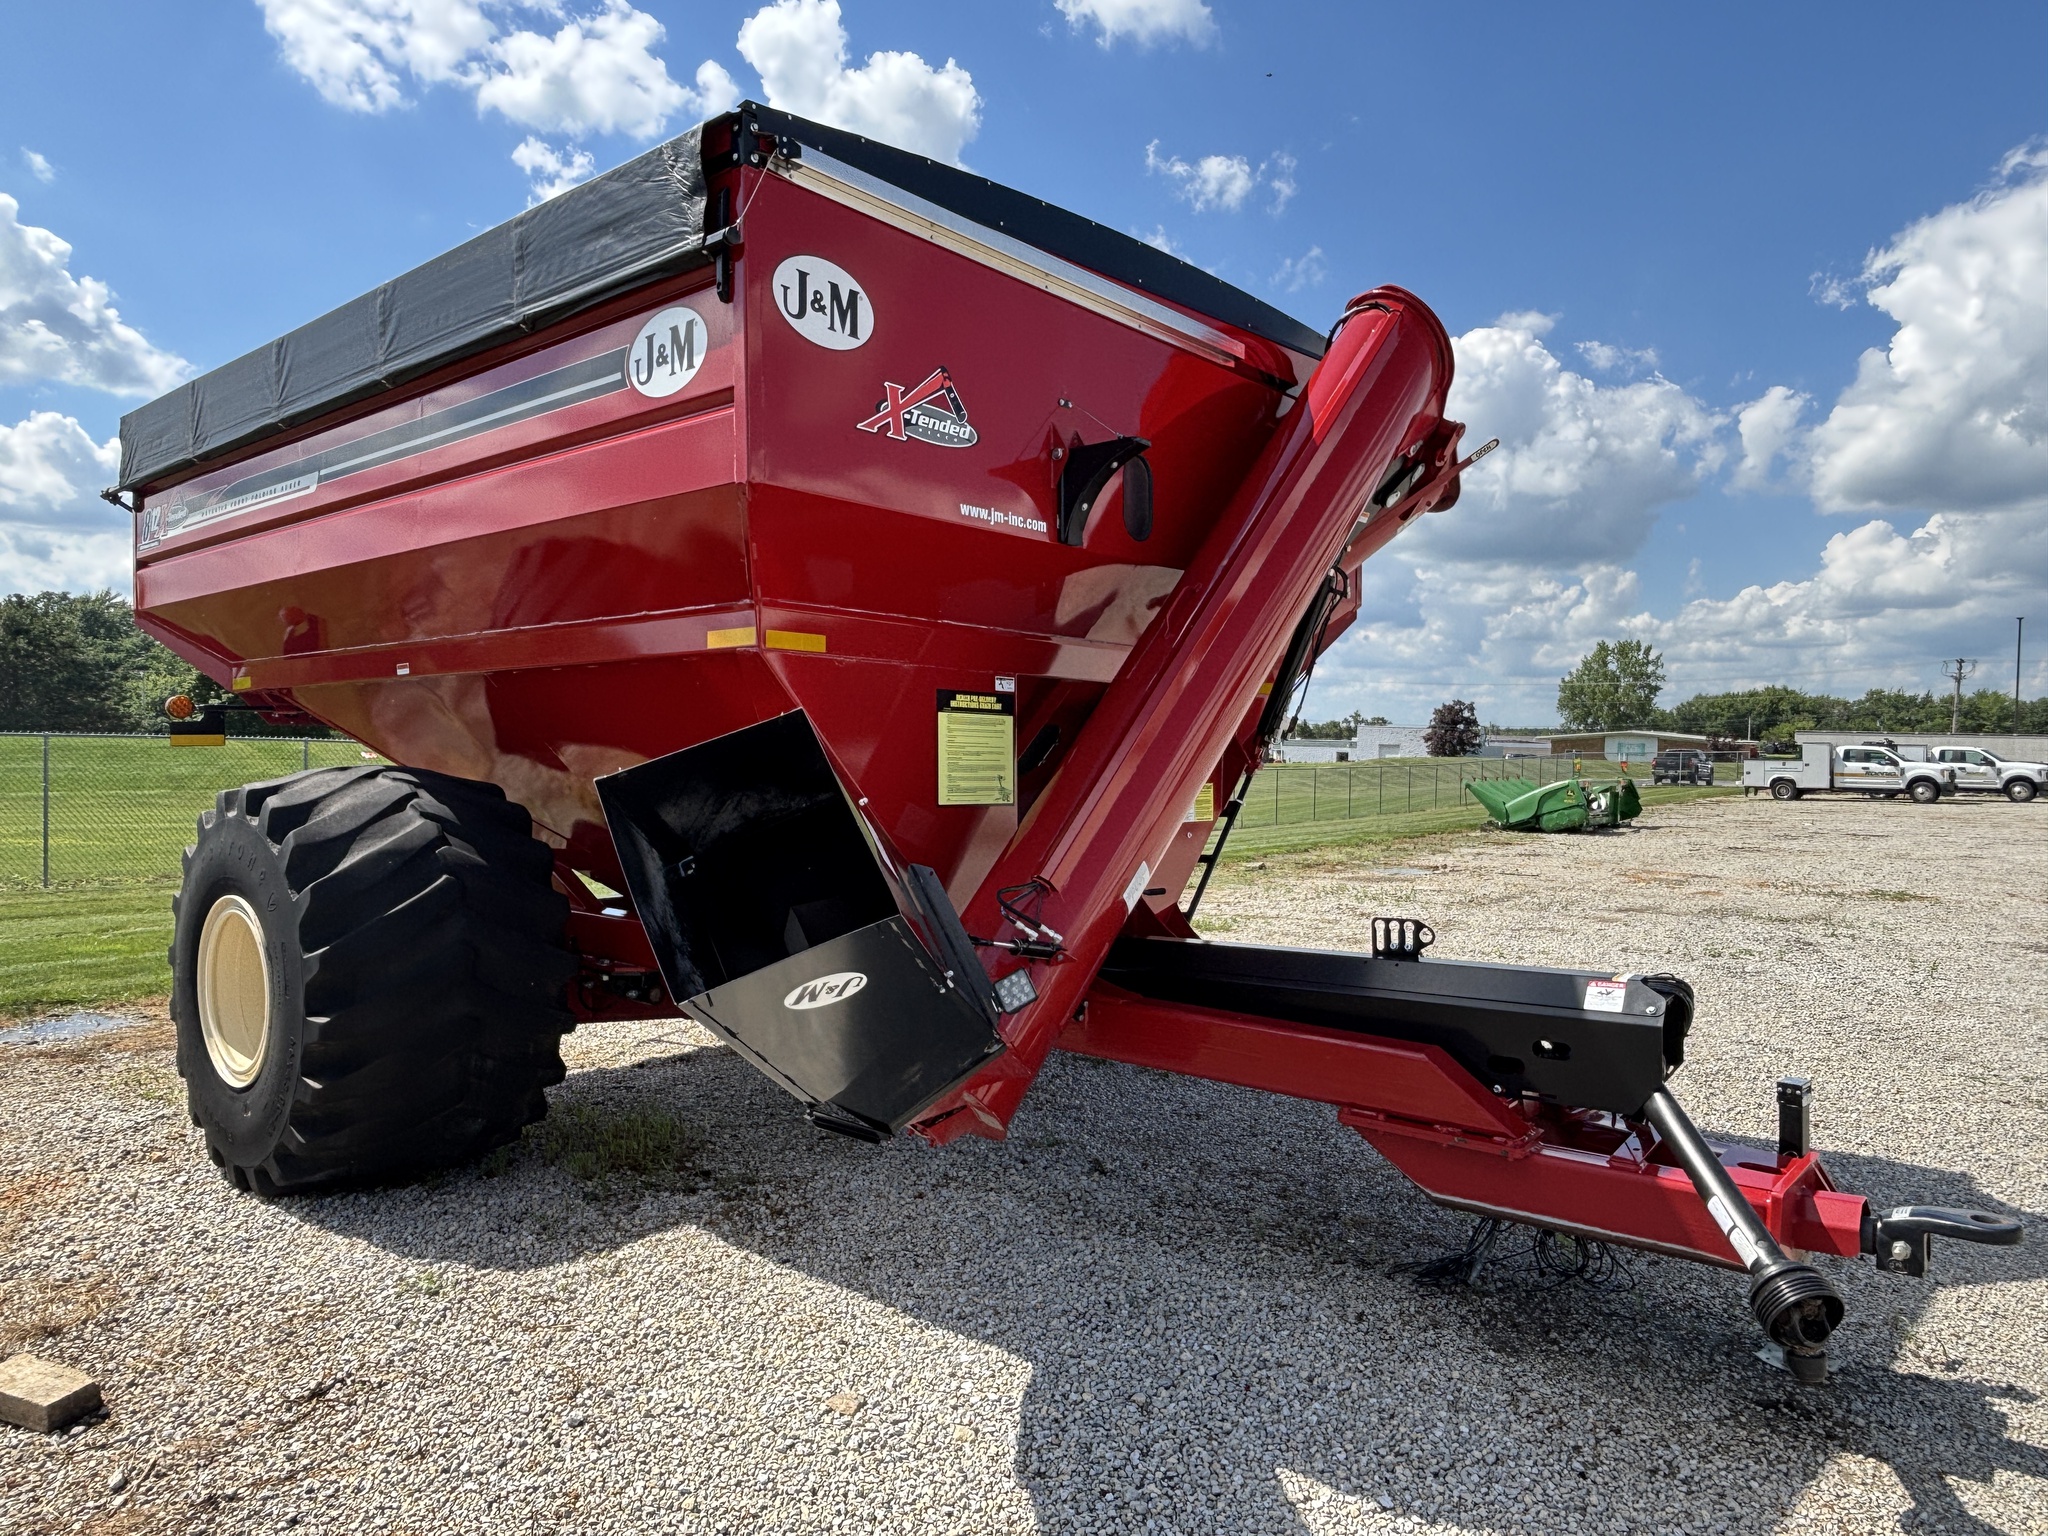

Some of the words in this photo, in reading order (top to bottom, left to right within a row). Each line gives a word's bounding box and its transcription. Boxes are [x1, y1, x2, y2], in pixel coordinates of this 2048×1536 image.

[781, 268, 861, 340] J&M
[634, 317, 696, 386] J&M
[959, 503, 1047, 533] www.jm-inc.com
[788, 976, 864, 1006] J&M
